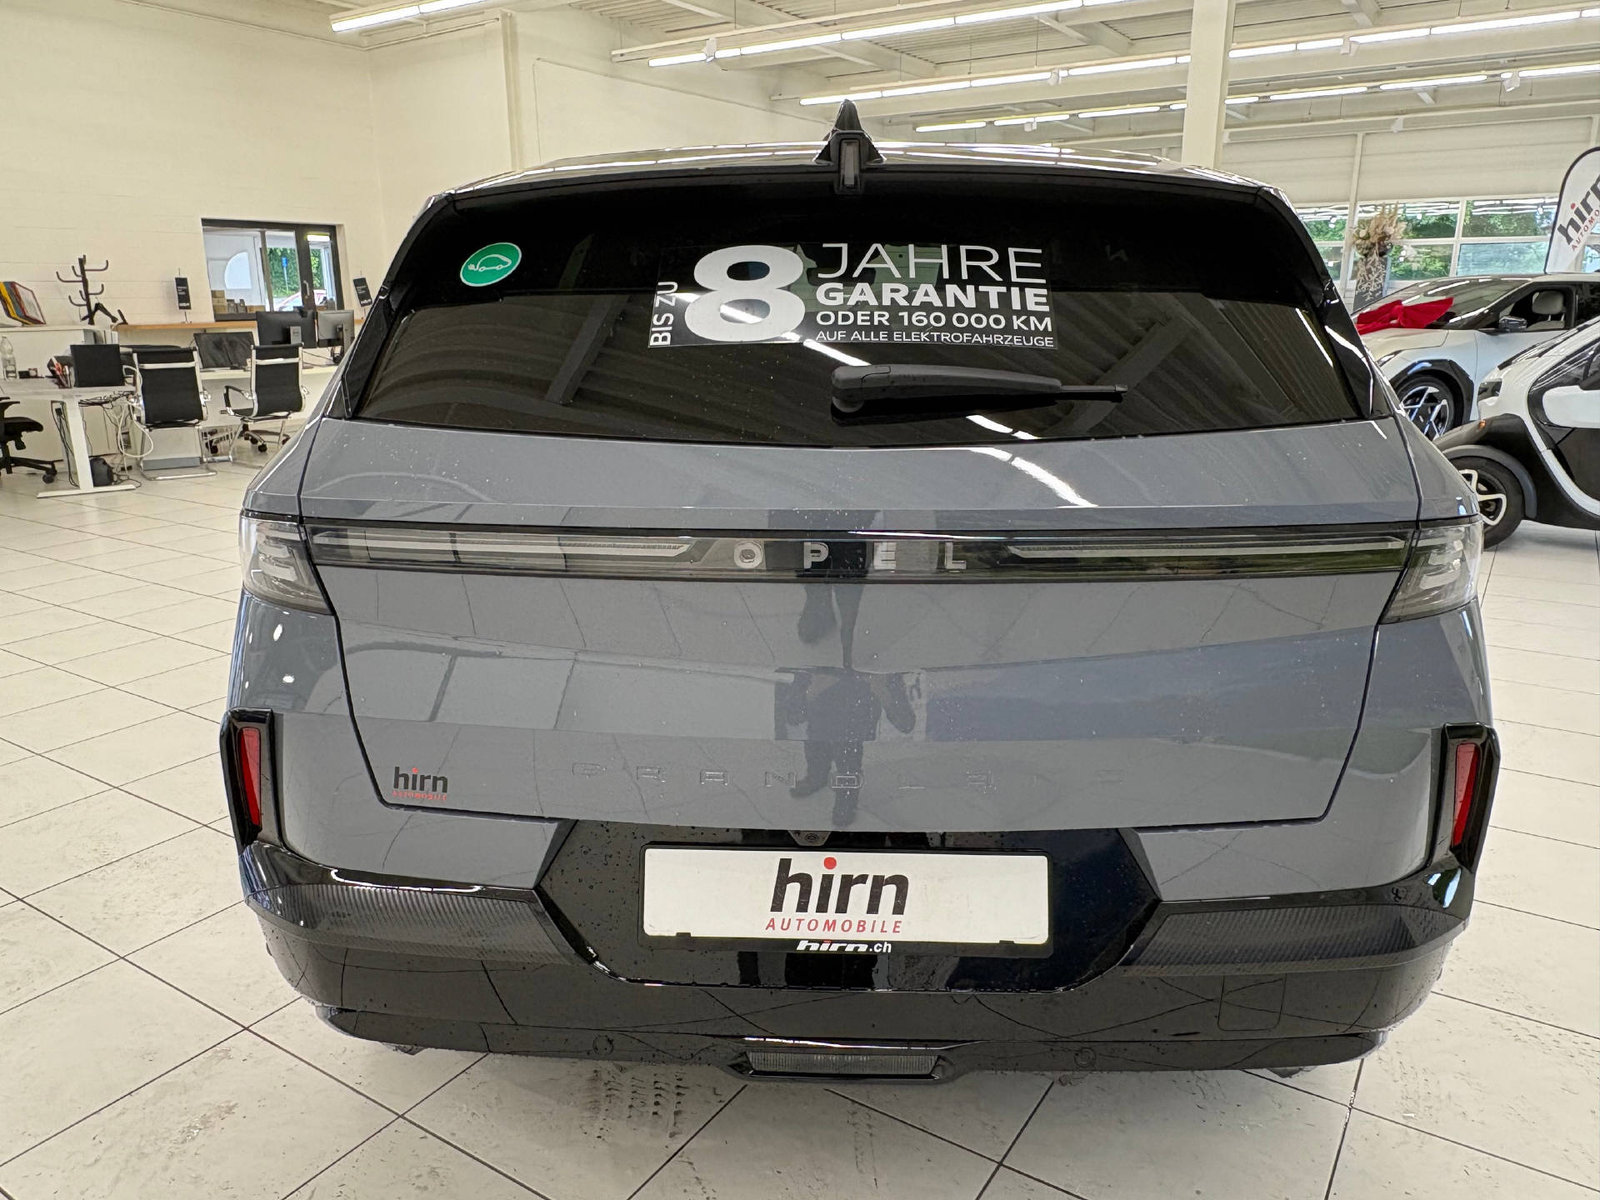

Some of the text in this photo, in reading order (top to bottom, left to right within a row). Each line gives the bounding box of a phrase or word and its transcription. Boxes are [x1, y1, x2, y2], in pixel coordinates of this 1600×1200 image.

[1571, 205, 1600, 252] AUTOMO
[817, 243, 1046, 284] JAHRE
[685, 245, 805, 341] 8
[816, 282, 1050, 312] GARANTIE
[650, 281, 678, 346] BIS ZU
[816, 311, 1053, 332] ODER 160 000 KM
[816, 330, 1054, 347] AUF ALLE ELEKTROFAHRZEUGE
[733, 541, 967, 570] OPEL
[393, 766, 448, 793] hirn
[770, 857, 909, 915] hirn
[765, 918, 903, 934] AUTOMOBILE
[796, 939, 892, 953] hirn.ch
